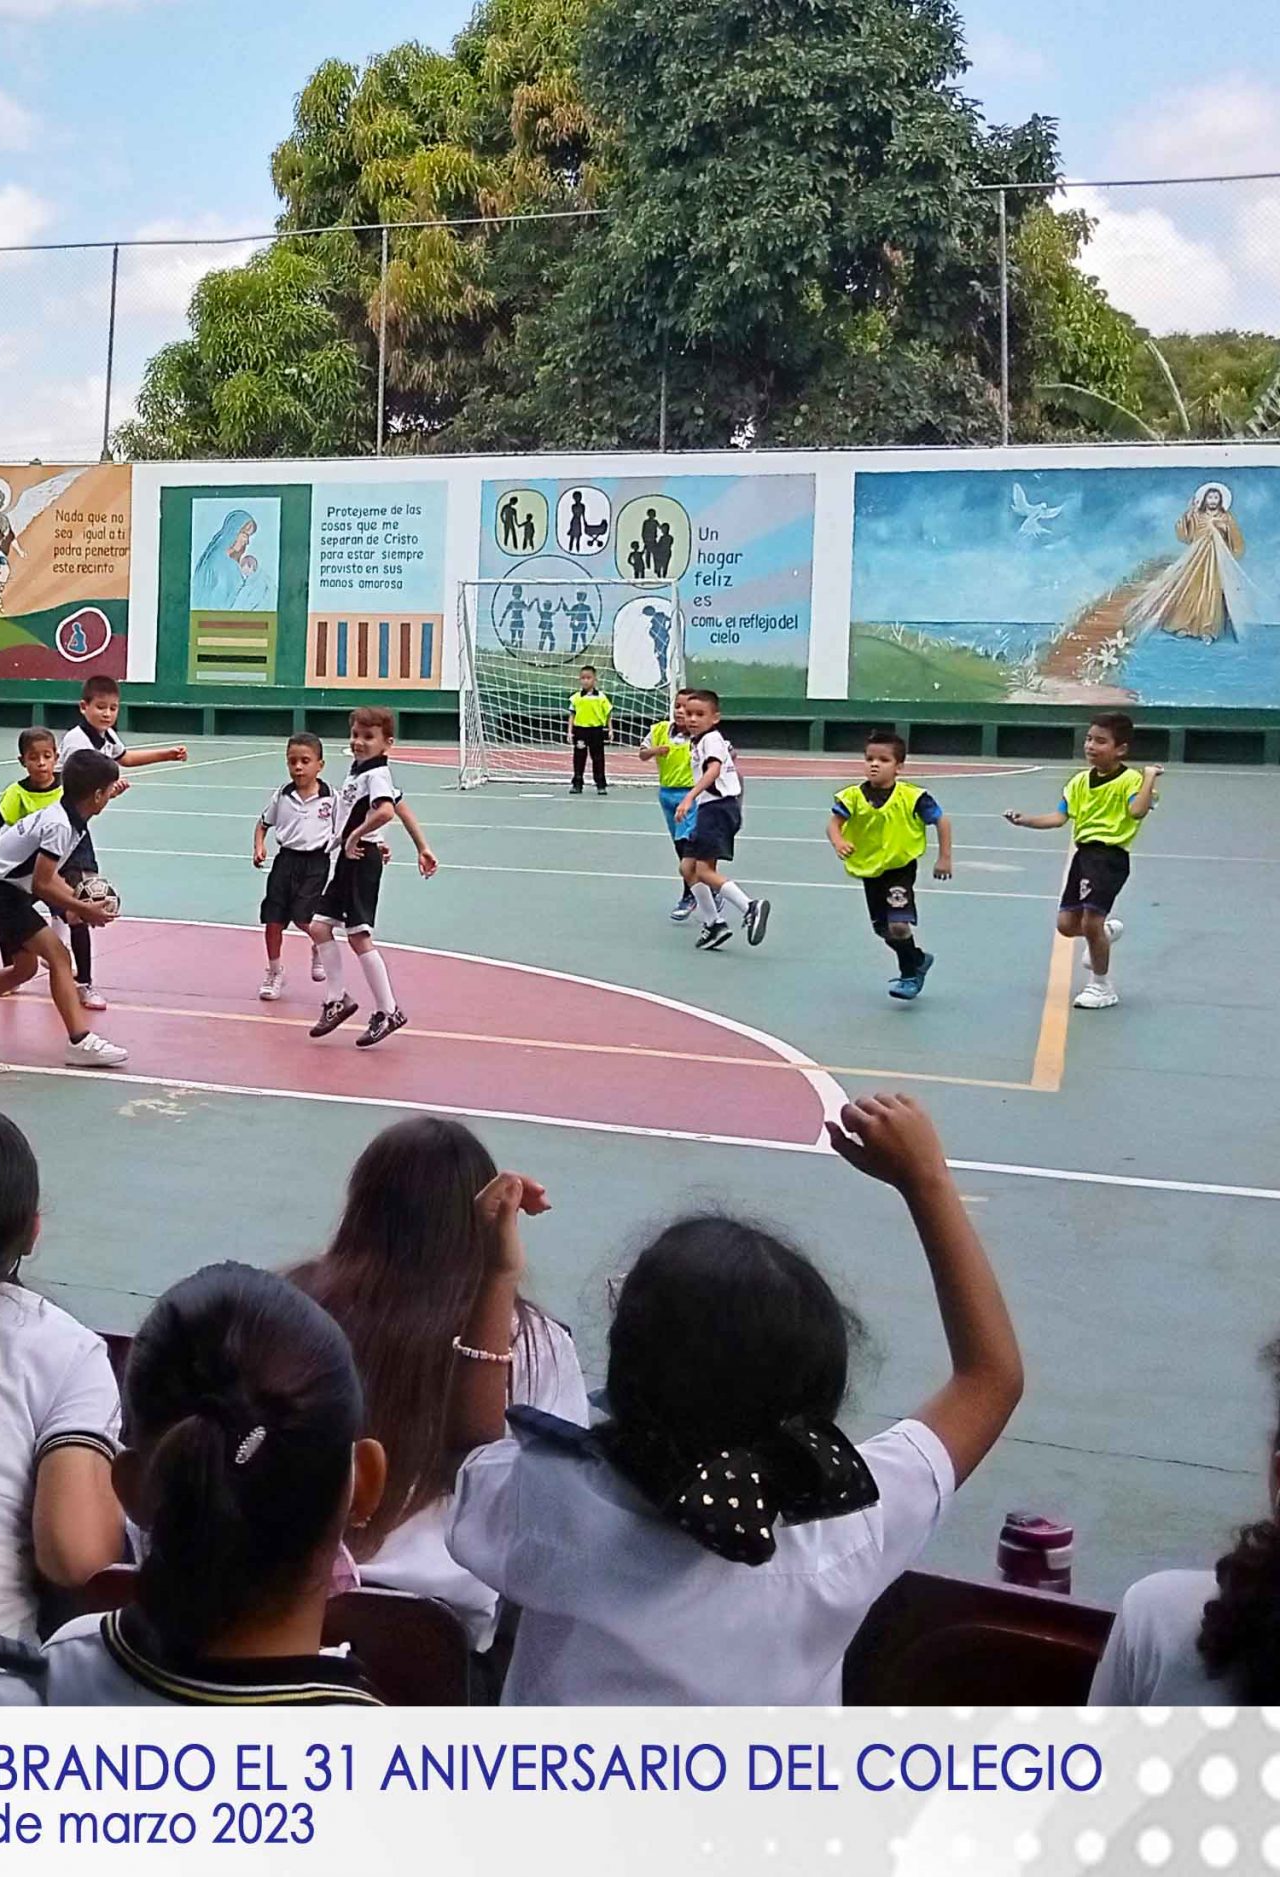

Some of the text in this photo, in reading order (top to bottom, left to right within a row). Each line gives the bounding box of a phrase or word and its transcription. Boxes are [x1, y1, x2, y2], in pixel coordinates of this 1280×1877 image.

[55, 509, 124, 527] Nada que no
[327, 504, 422, 519] Protejeme de las
[54, 526, 125, 544] sea igual a ti
[321, 521, 399, 534] cosas que me
[699, 526, 719, 541] Un
[320, 533, 419, 547] separan de Cristo
[54, 542, 82, 559] podra
[320, 550, 424, 562] para estar siempre
[697, 548, 744, 570] hogar
[52, 561, 115, 574] este recinto
[320, 563, 403, 577] provisto en sus
[319, 579, 403, 589] manos amorosa
[694, 570, 733, 587] feliz
[693, 595, 712, 607] es
[739, 614, 777, 633] reflejo
[778, 614, 798, 629] del
[710, 629, 740, 644] cielo
